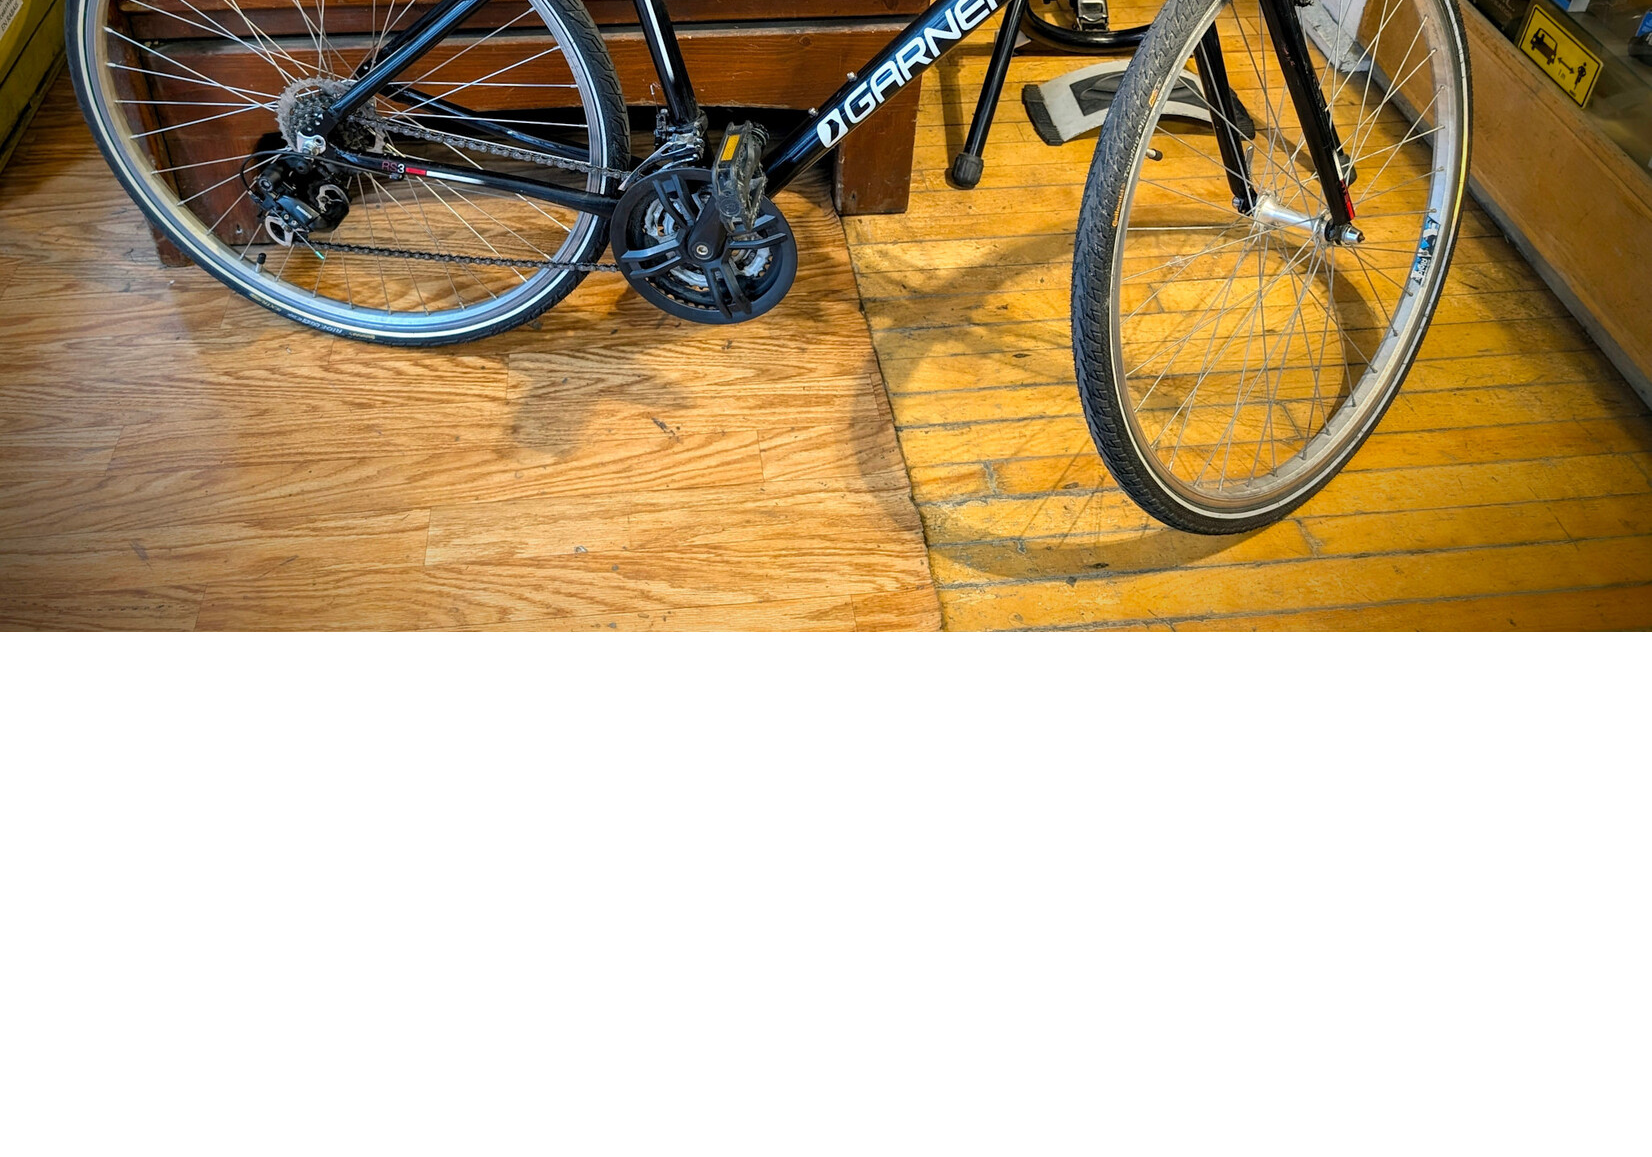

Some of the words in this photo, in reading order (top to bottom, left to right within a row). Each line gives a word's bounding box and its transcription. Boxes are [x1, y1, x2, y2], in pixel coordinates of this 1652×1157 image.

[1123, 135, 1141, 178] Touring
[1137, 109, 1150, 135] Plus
[382, 160, 405, 174] RS3
